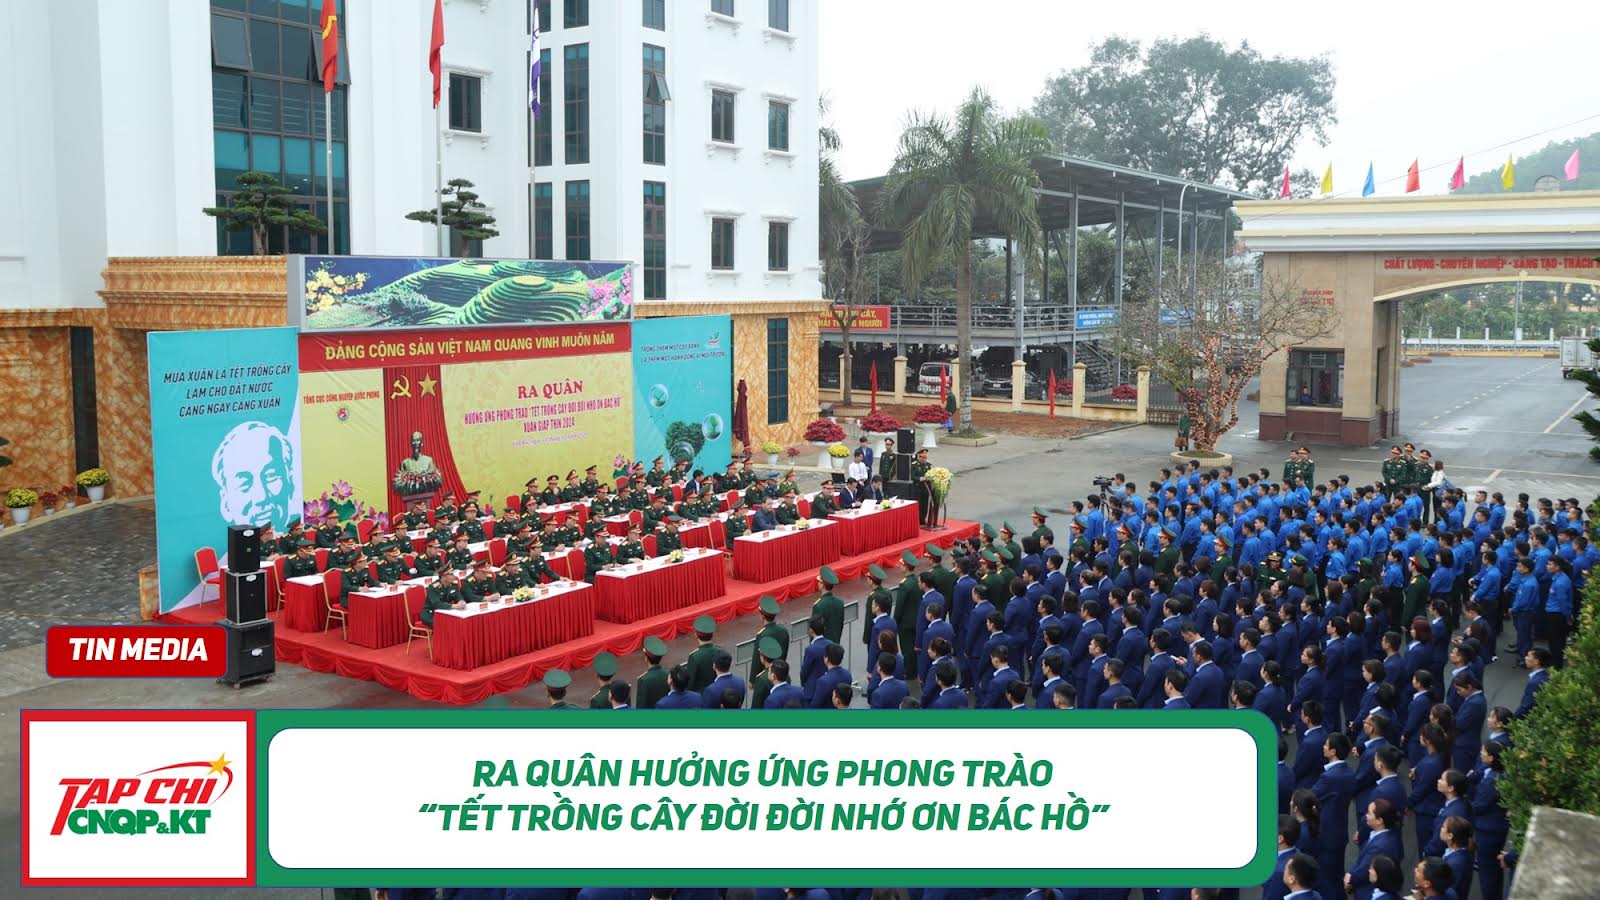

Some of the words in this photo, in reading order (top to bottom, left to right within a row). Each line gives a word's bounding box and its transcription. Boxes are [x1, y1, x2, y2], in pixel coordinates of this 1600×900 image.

[325, 340, 364, 360] ĐẢNG
[369, 340, 405, 362] CỘNG
[409, 337, 434, 356] SẢN
[438, 338, 462, 358] VIỆT
[466, 340, 491, 352] NAM
[494, 338, 532, 351] QUANG
[536, 336, 559, 348] VINH
[562, 332, 590, 347] MUÔN
[593, 331, 614, 344] NĂM
[208, 386, 227, 397] CHO
[518, 385, 538, 399] RA
[543, 378, 582, 399] QUÂN
